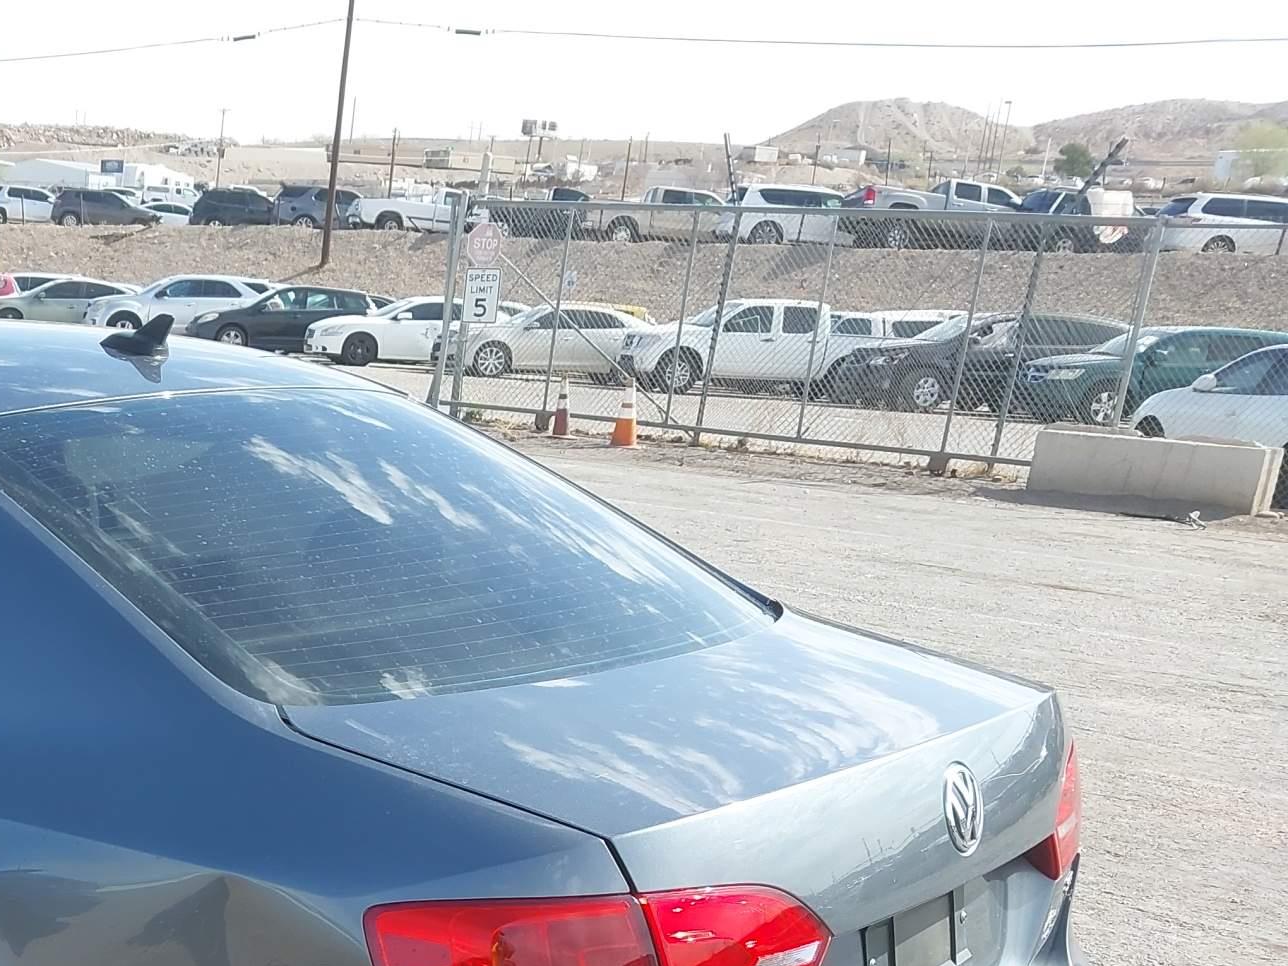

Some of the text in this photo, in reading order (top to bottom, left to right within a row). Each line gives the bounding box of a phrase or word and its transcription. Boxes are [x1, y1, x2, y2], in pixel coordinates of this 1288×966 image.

[473, 238, 498, 250] STOP
[468, 273, 498, 282] SPEED
[470, 285, 493, 294] LIMIT
[473, 297, 487, 318] 5
